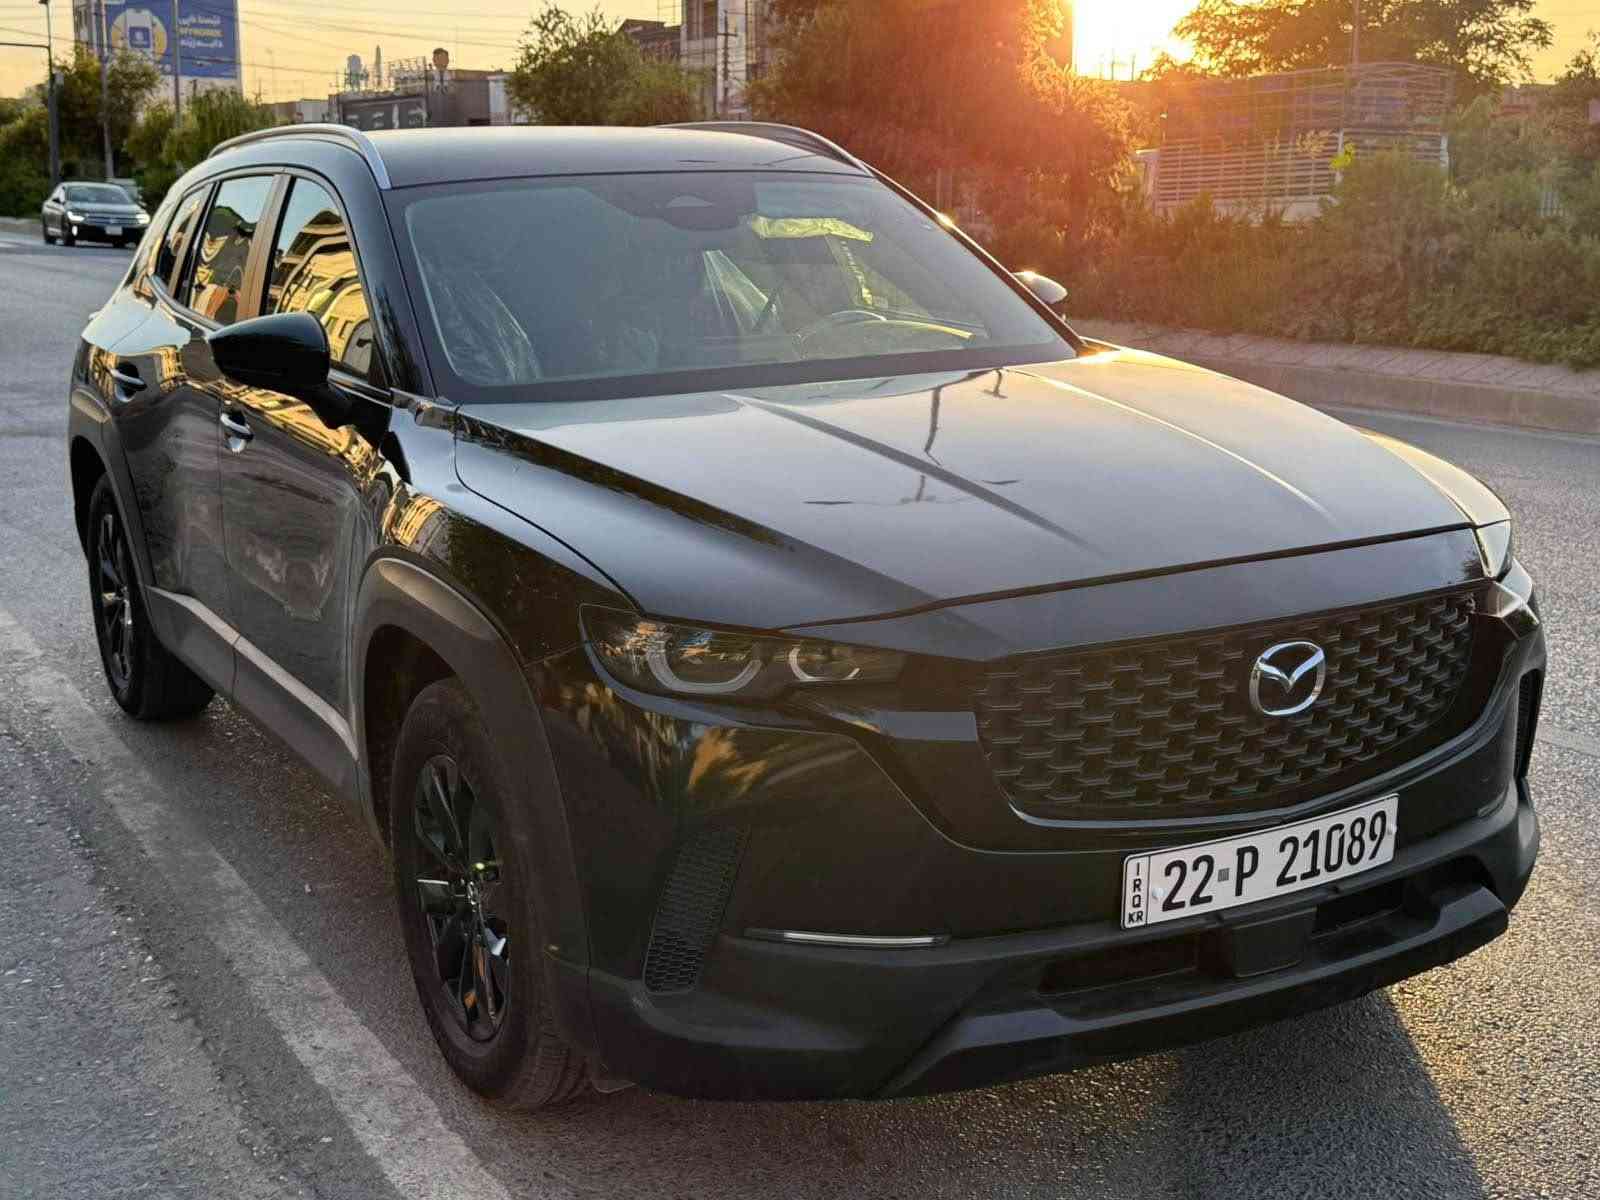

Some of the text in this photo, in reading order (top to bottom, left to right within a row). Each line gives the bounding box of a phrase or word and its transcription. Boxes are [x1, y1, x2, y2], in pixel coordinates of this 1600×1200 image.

[1161, 810, 1387, 912] 22 P 21089
[1131, 862, 1142, 908] IRQ
[1127, 910, 1144, 924] KR
